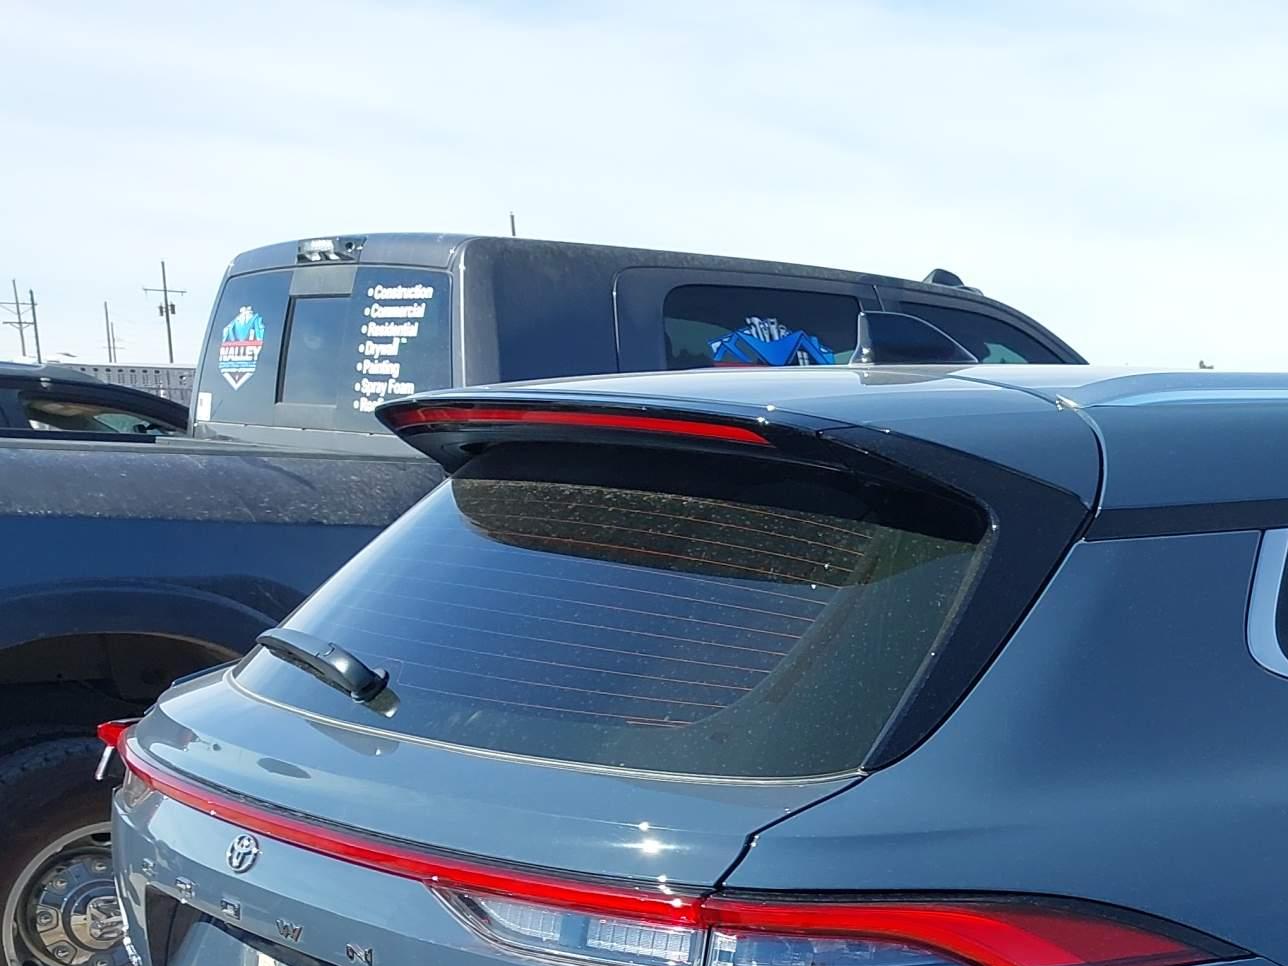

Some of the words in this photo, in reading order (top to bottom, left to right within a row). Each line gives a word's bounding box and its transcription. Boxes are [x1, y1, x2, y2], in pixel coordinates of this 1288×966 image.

[373, 284, 434, 300] Construction
[370, 302, 426, 318] Commercial
[367, 321, 419, 337] Residential
[364, 337, 400, 359] Drywall
[362, 359, 401, 379] Painting
[360, 378, 387, 397] Spray
[387, 378, 415, 395] Foam
